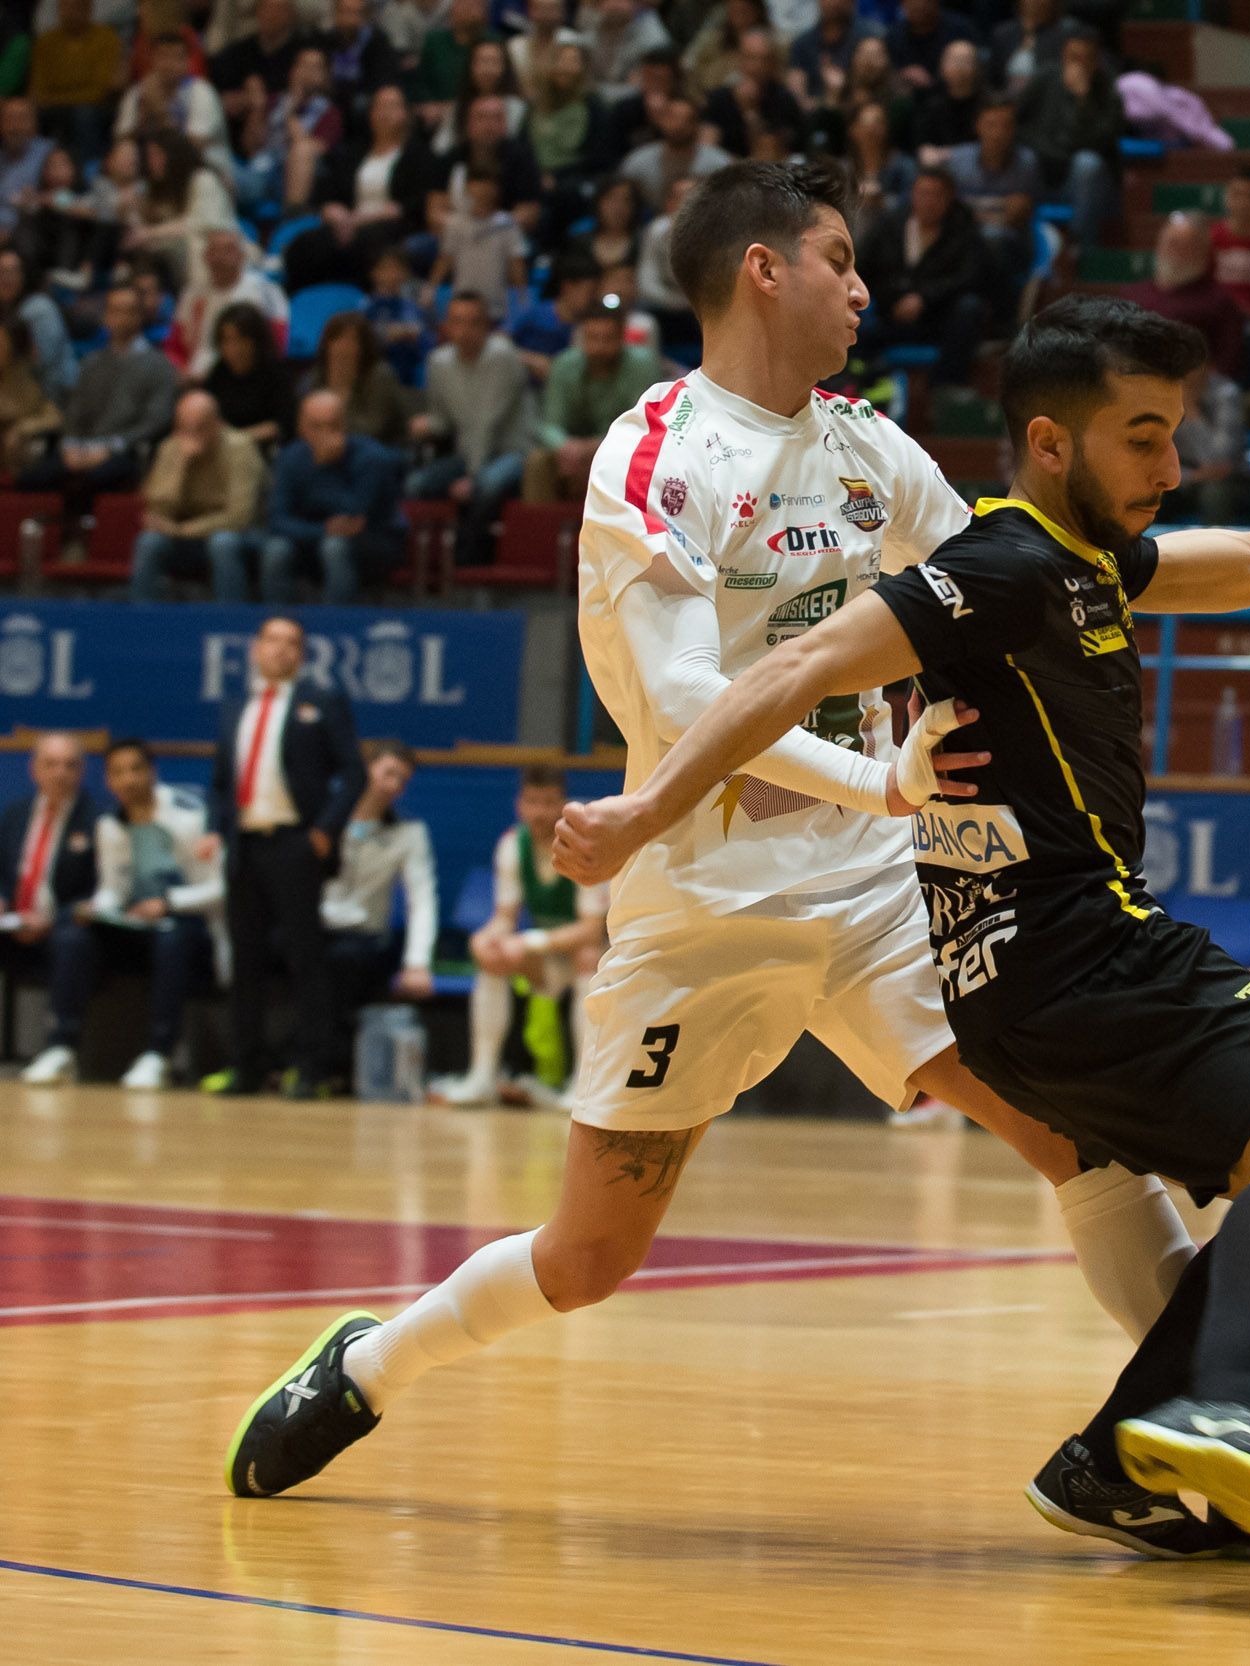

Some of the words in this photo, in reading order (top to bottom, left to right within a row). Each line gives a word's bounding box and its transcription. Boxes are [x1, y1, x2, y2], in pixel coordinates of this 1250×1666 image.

[769, 587, 839, 621] FINISHER
[202, 619, 464, 703] FRROL
[912, 811, 1017, 863] BANCA
[626, 1023, 680, 1088] 3
